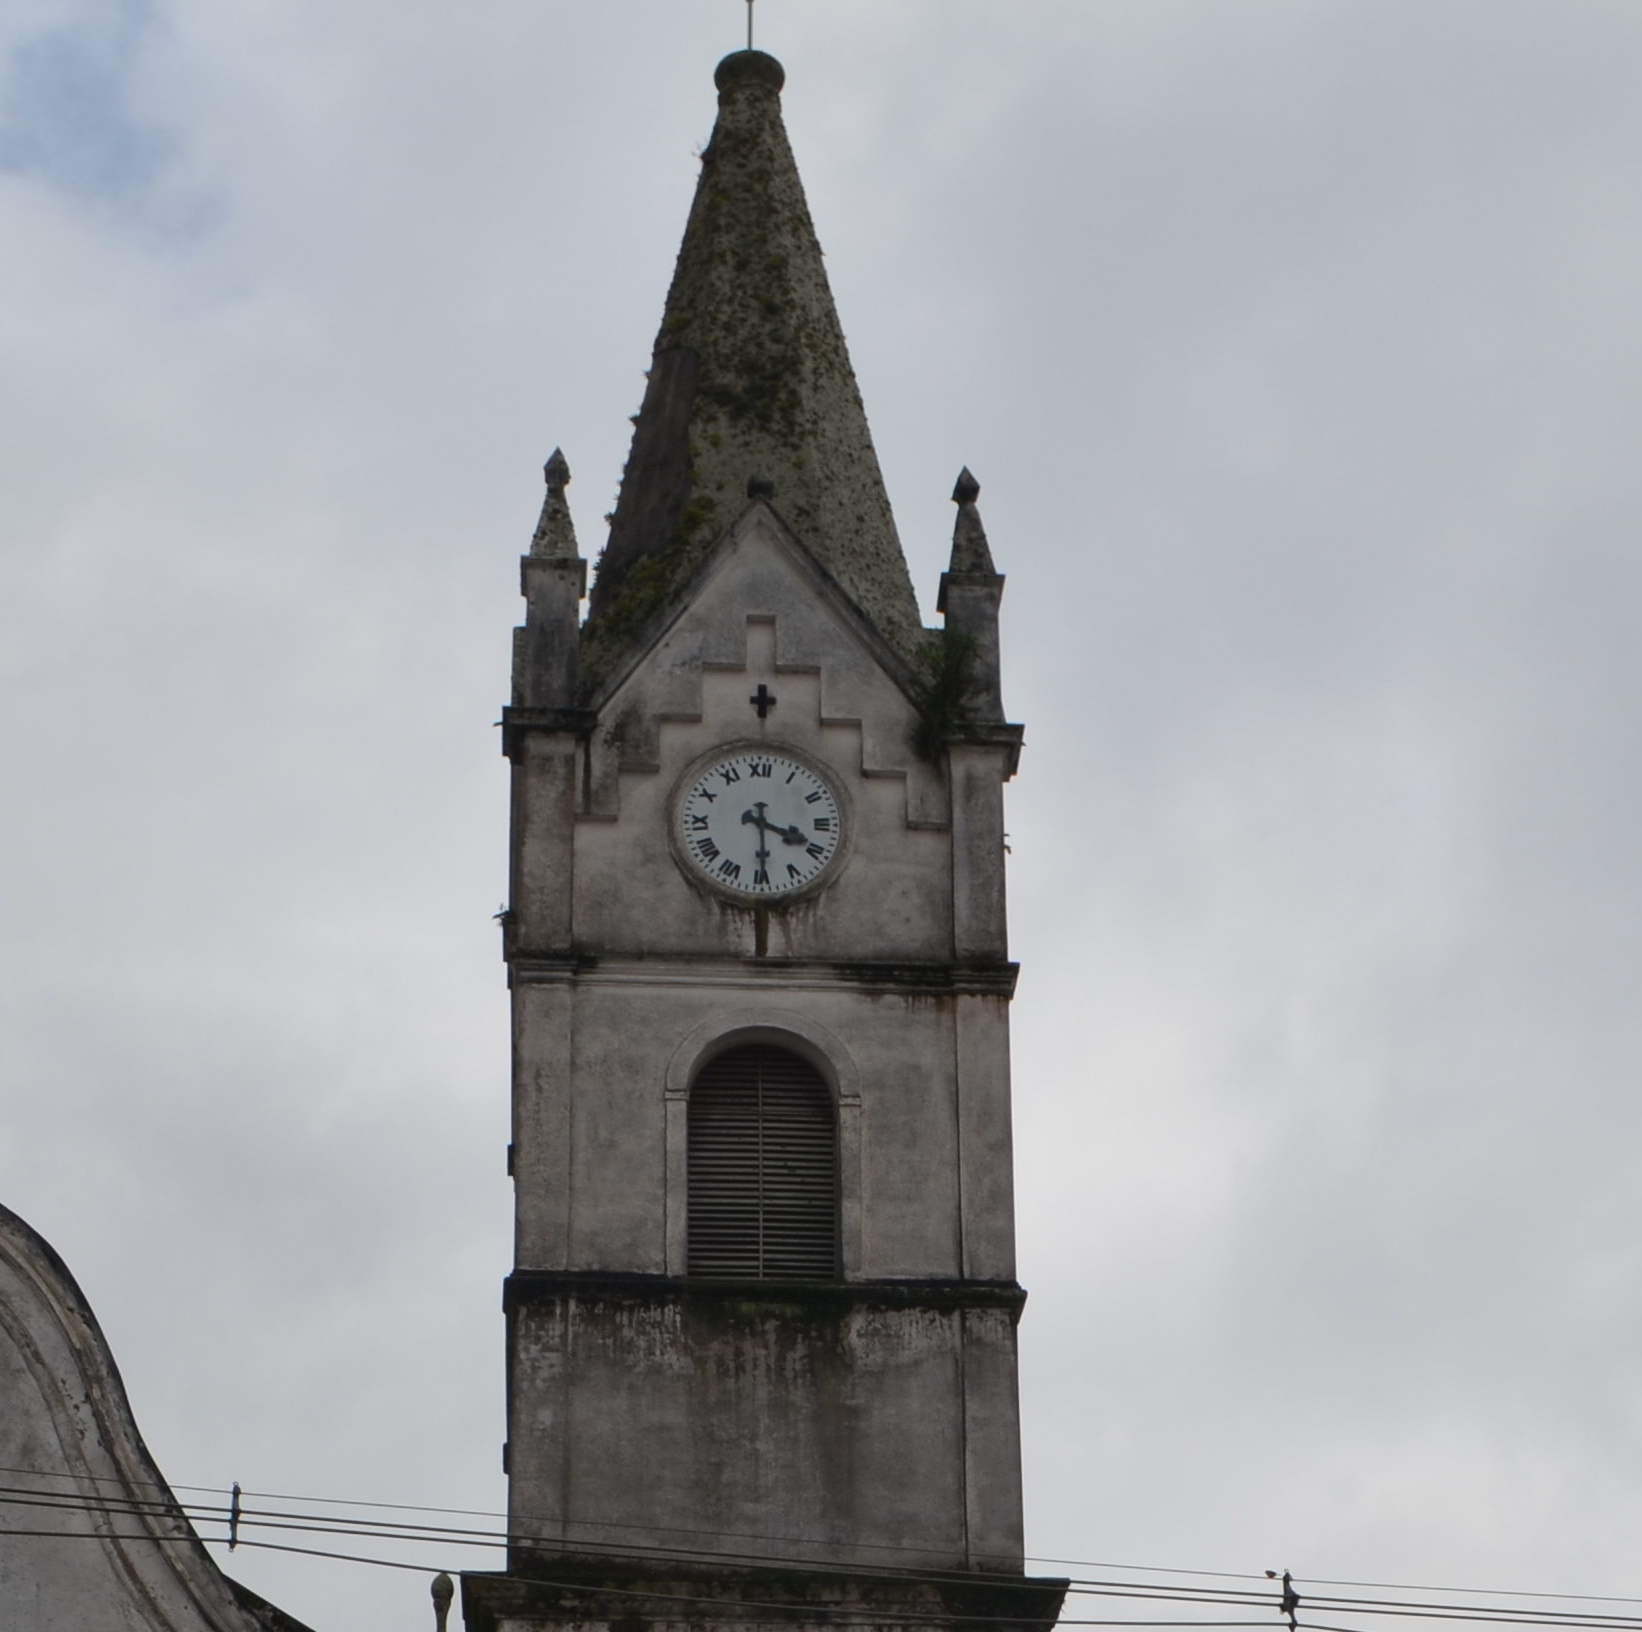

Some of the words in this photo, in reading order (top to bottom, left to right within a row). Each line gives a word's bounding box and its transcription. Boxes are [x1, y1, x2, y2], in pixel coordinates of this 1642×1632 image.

[720, 767, 741, 786] XI
[748, 763, 772, 778] XII
[698, 787, 718, 803] X
[804, 791, 822, 805] II
[813, 817, 830, 832] III
